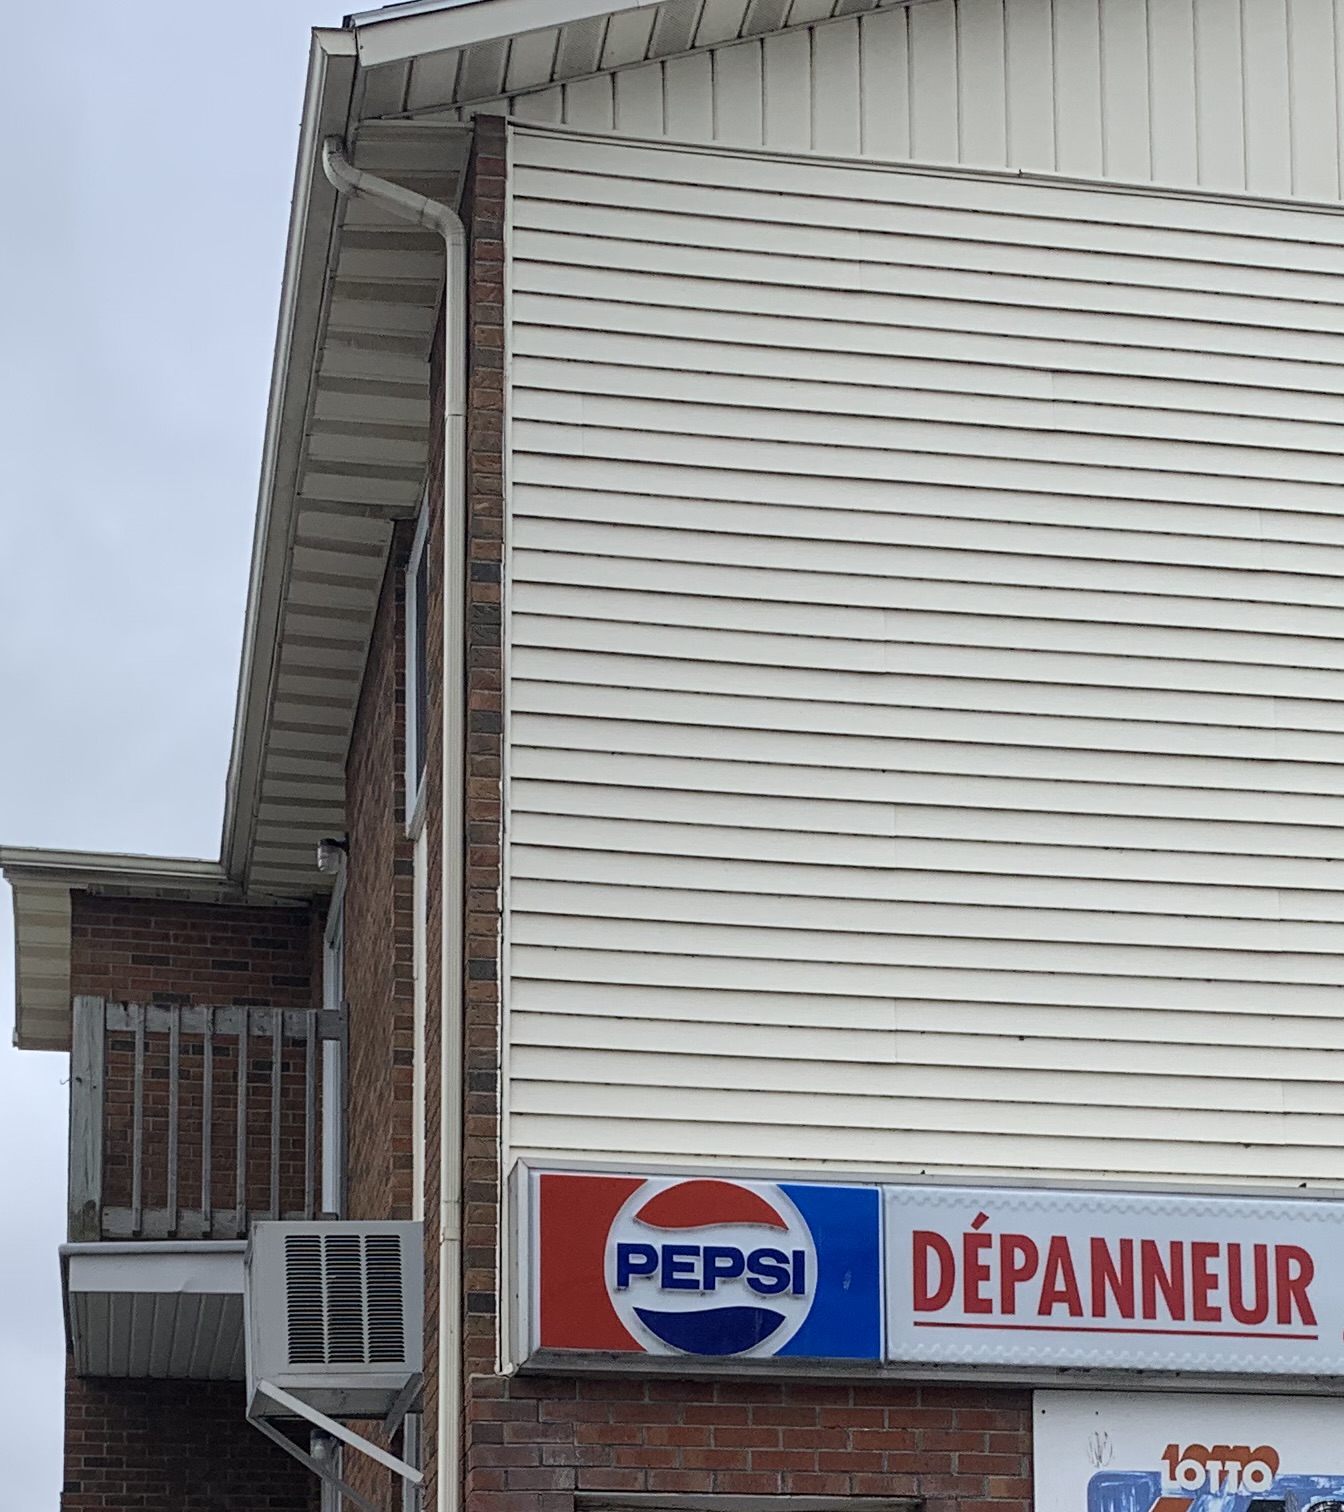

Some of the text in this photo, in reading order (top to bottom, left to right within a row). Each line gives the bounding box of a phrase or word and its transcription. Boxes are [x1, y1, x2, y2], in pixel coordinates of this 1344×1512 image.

[614, 1241, 807, 1298] PEPSI
[910, 1213, 1318, 1328] DÉPANNEUR
[1161, 1443, 1280, 1493] LOTTO
